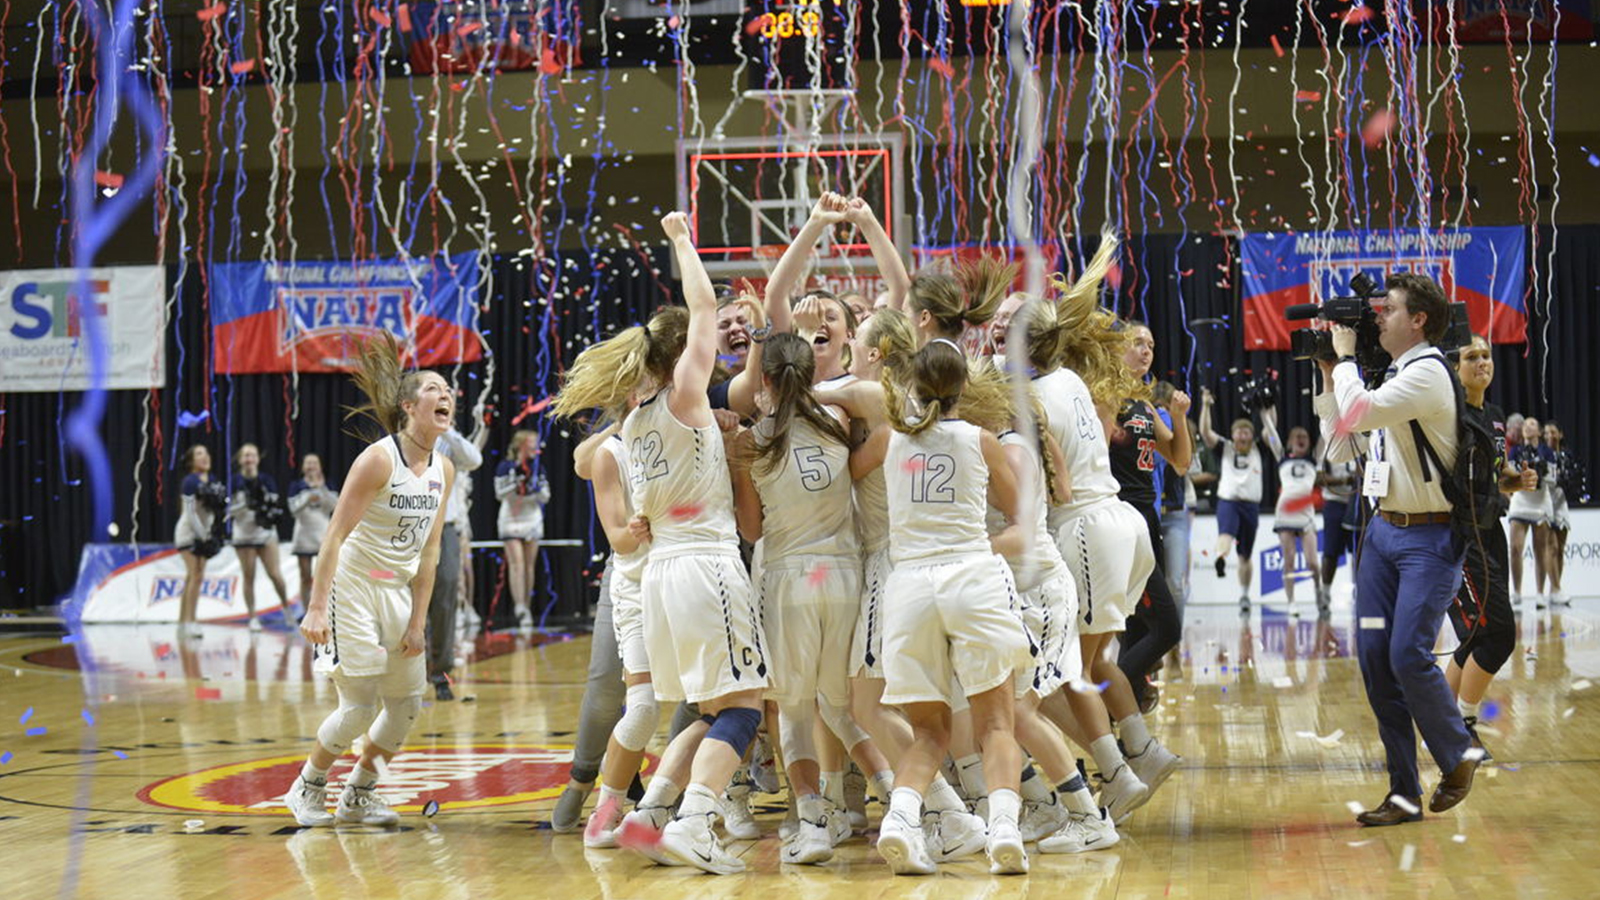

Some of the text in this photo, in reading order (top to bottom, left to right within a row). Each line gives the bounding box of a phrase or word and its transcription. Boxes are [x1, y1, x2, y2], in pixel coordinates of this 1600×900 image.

[1295, 236, 1360, 254] NATIONAL
[10, 280, 110, 340] STF
[283, 292, 408, 342] NAIA
[0, 342, 66, 360] eaboard
[1074, 396, 1096, 440] 4
[630, 430, 669, 484] 42
[794, 446, 831, 492] 5
[909, 454, 956, 503] 12
[389, 494, 438, 511] CONCORDIA
[154, 578, 231, 601] NIA
[742, 646, 753, 667] C
